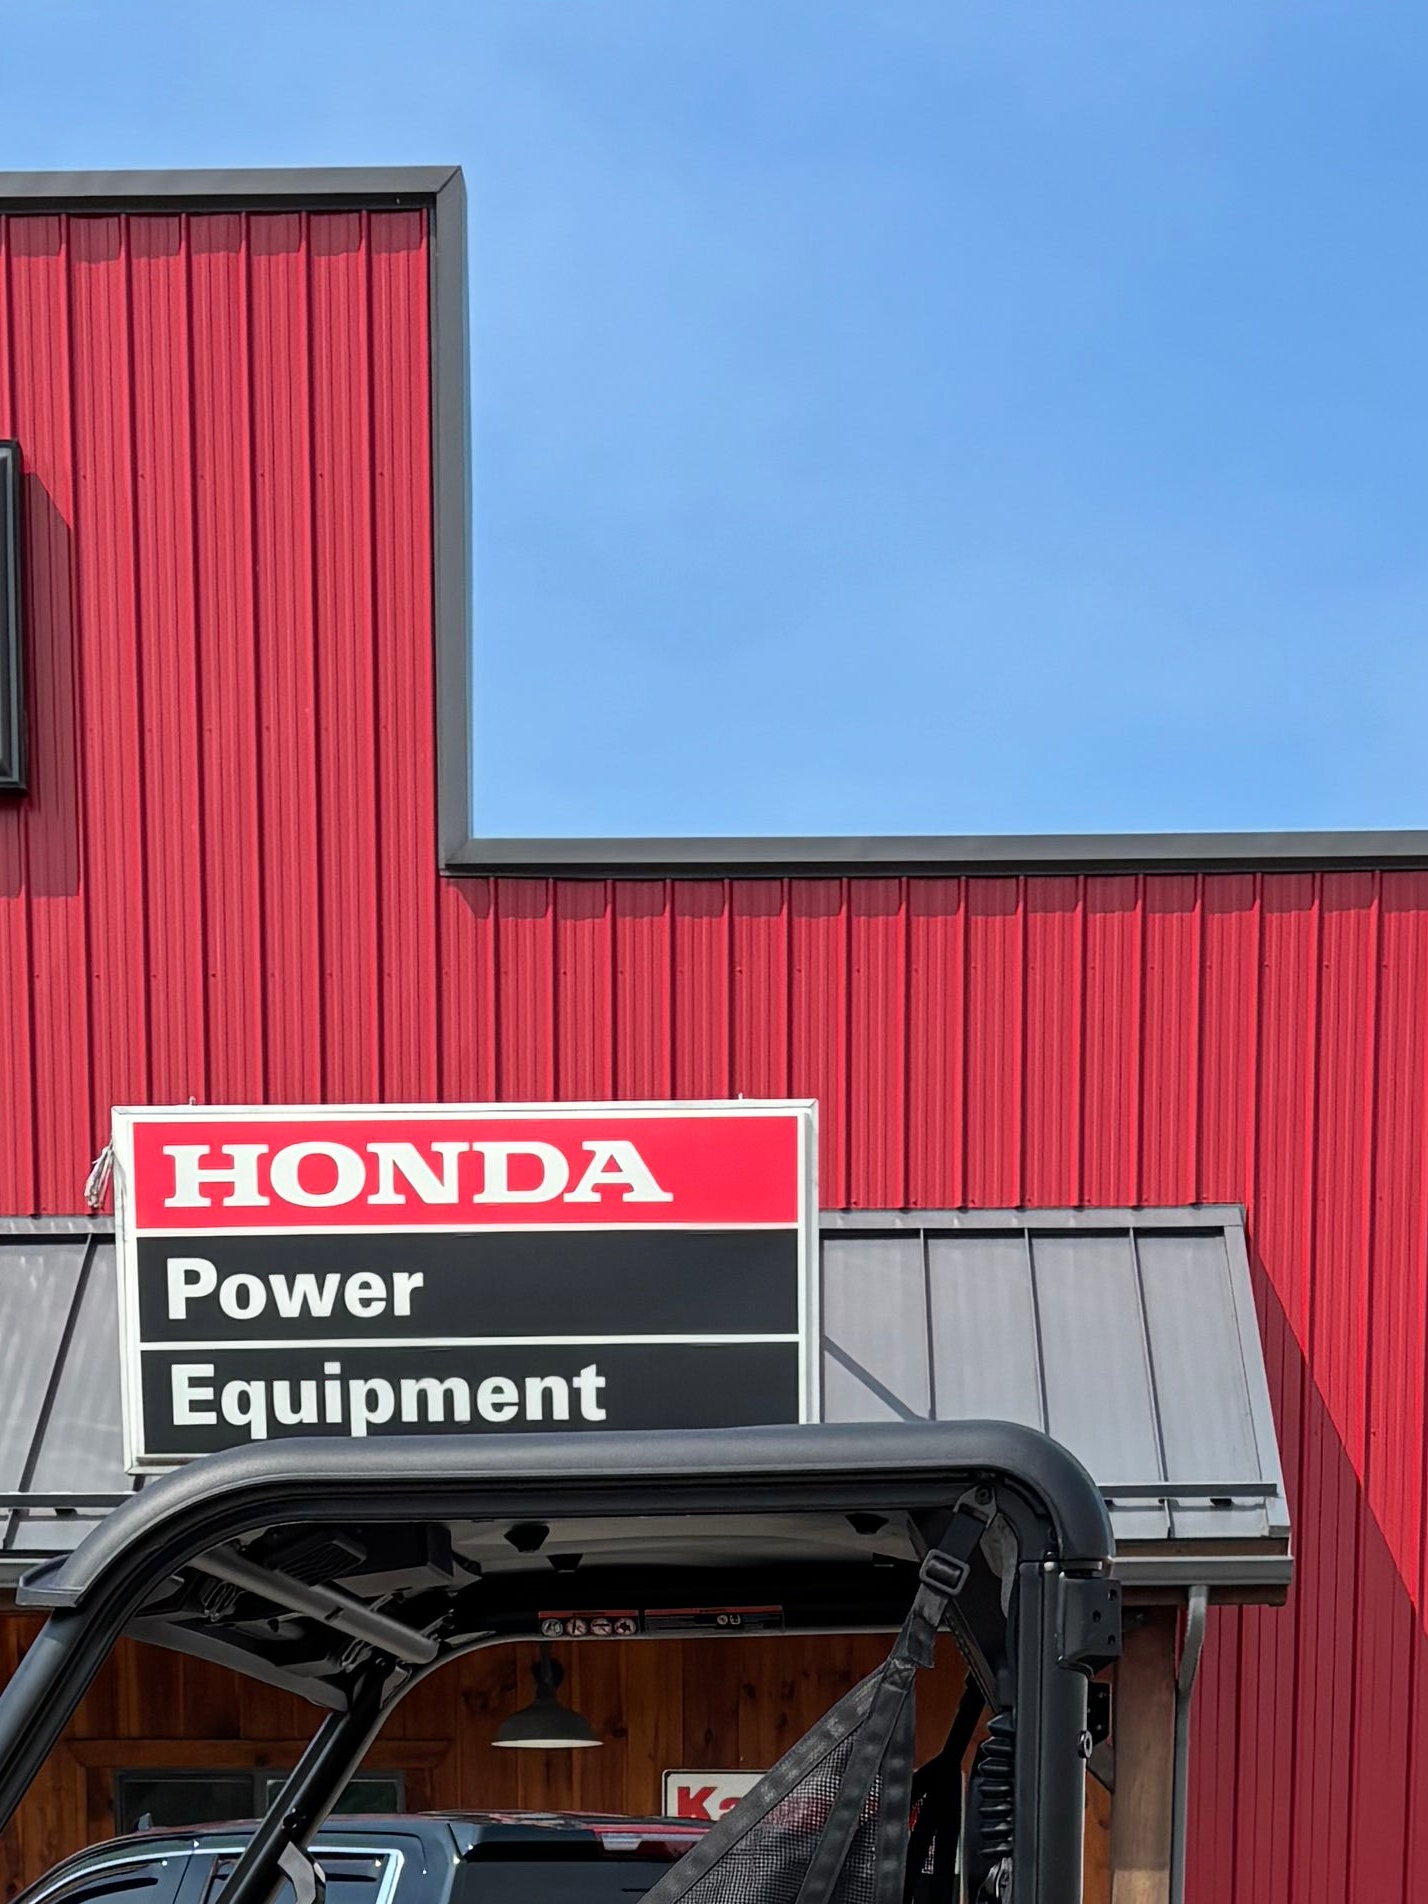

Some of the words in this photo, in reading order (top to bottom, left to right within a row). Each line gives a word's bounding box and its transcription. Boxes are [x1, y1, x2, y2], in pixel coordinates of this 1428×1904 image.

[162, 1139, 674, 1209] HONDA
[166, 1257, 425, 1321] Power
[170, 1360, 608, 1439] Equipment
